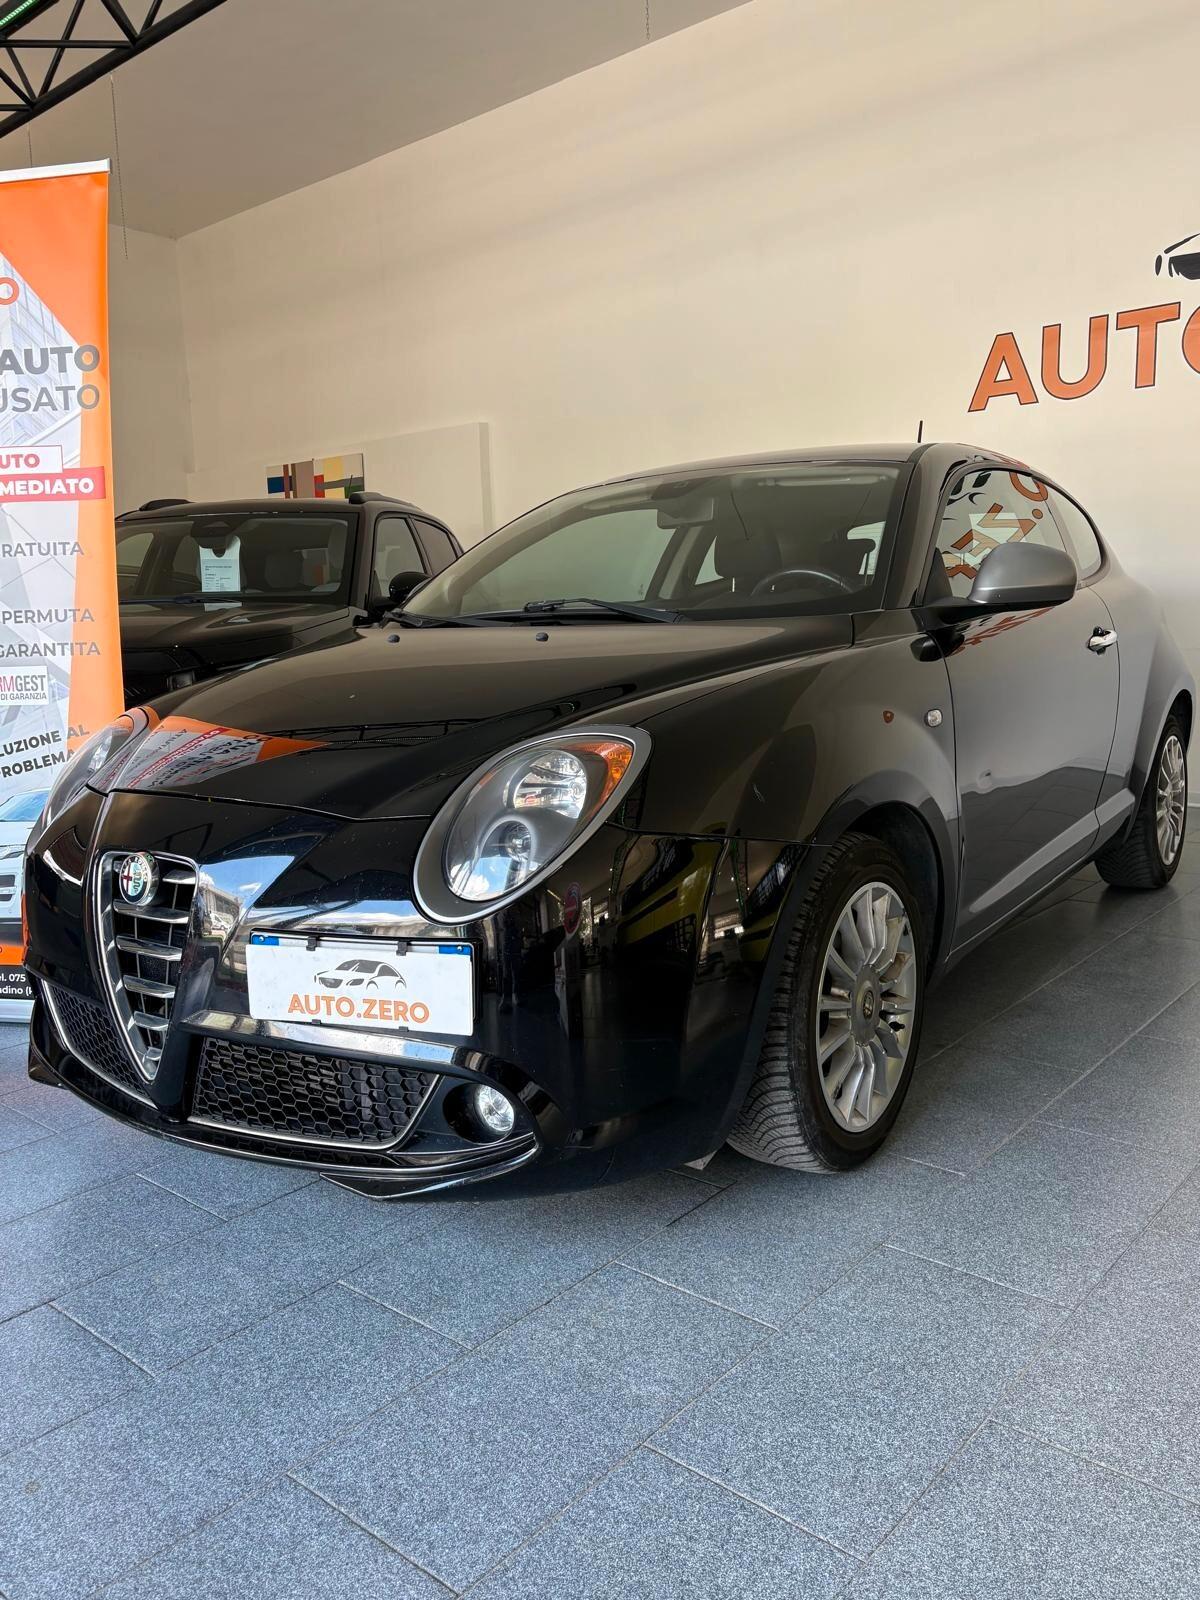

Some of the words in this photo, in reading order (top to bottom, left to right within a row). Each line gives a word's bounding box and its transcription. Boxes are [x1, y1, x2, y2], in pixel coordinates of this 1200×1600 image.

[0, 344, 100, 376] AUTO
[967, 301, 1200, 413] AUT
[2, 541, 84, 558] RATUITA
[2, 608, 95, 625] PERMUTA
[9, 692, 47, 701] GARANZIA
[67, 724, 90, 739] AL
[0, 748, 75, 778] ROBLEMA
[9, 973, 26, 982] 075
[287, 994, 430, 1024] AUTO.ZERO
